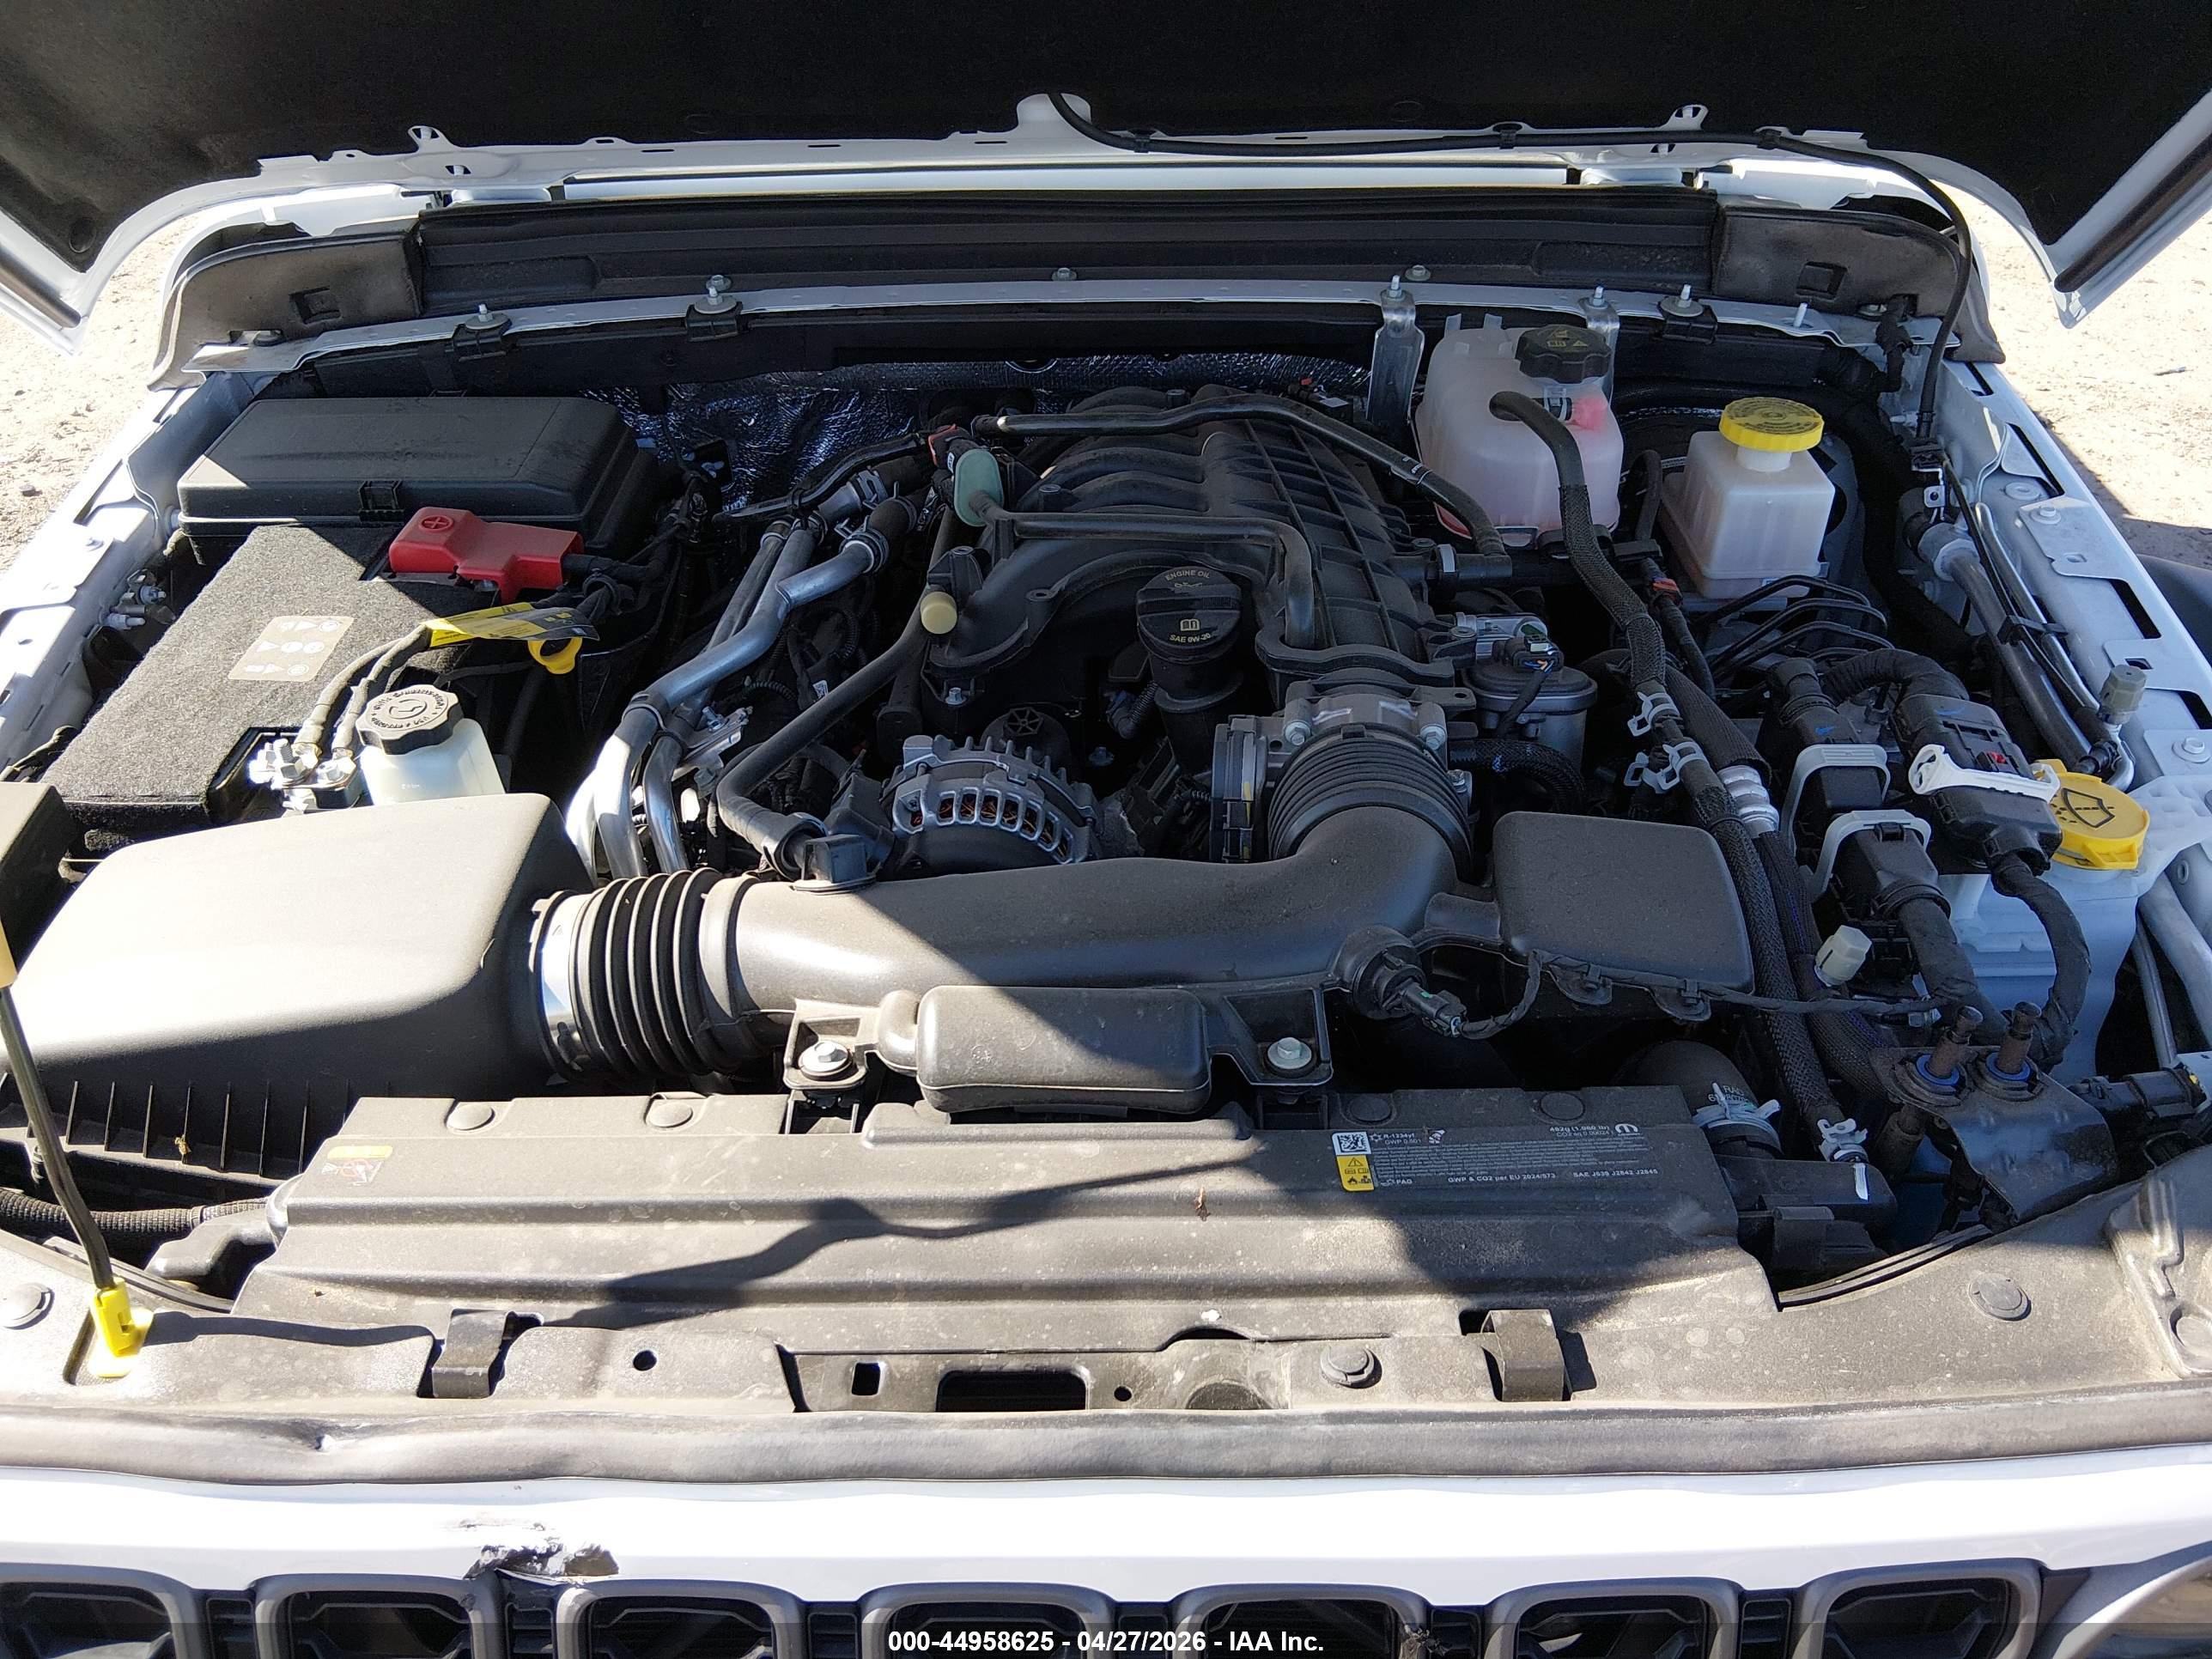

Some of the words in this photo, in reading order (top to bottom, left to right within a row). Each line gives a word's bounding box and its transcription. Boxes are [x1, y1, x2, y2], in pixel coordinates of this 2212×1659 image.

[1164, 569, 1196, 581] ENGINE
[1197, 569, 1211, 579] OIL
[1170, 634, 1187, 643] SAE
[1188, 633, 1212, 643] 0W-20
